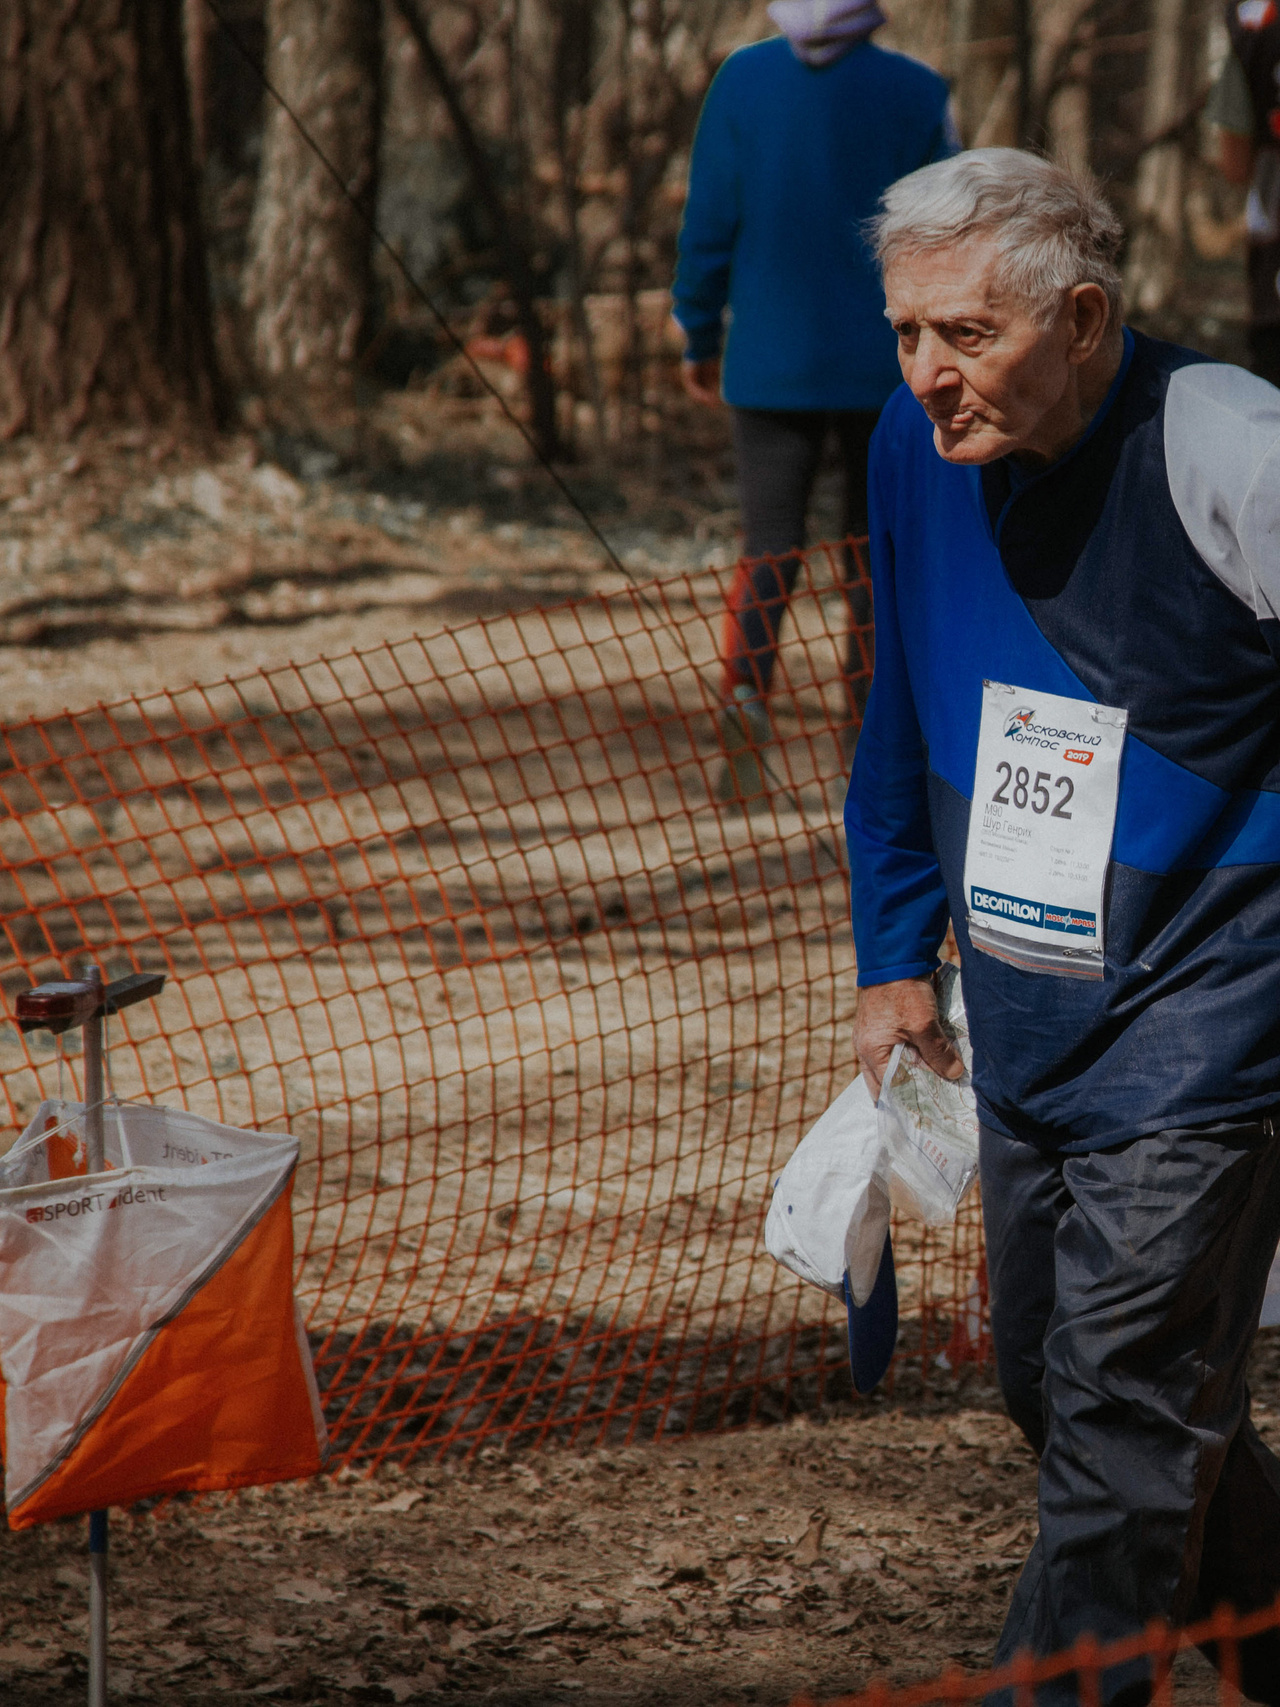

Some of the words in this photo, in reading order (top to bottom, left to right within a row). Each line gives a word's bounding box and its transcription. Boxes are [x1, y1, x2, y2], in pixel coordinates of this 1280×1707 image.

[1066, 751, 1090, 762] 2019
[991, 761, 1075, 820] 2852
[983, 815, 1001, 832] Шур
[1002, 820, 1033, 838] Генрих
[974, 891, 1041, 922] DECATHLON
